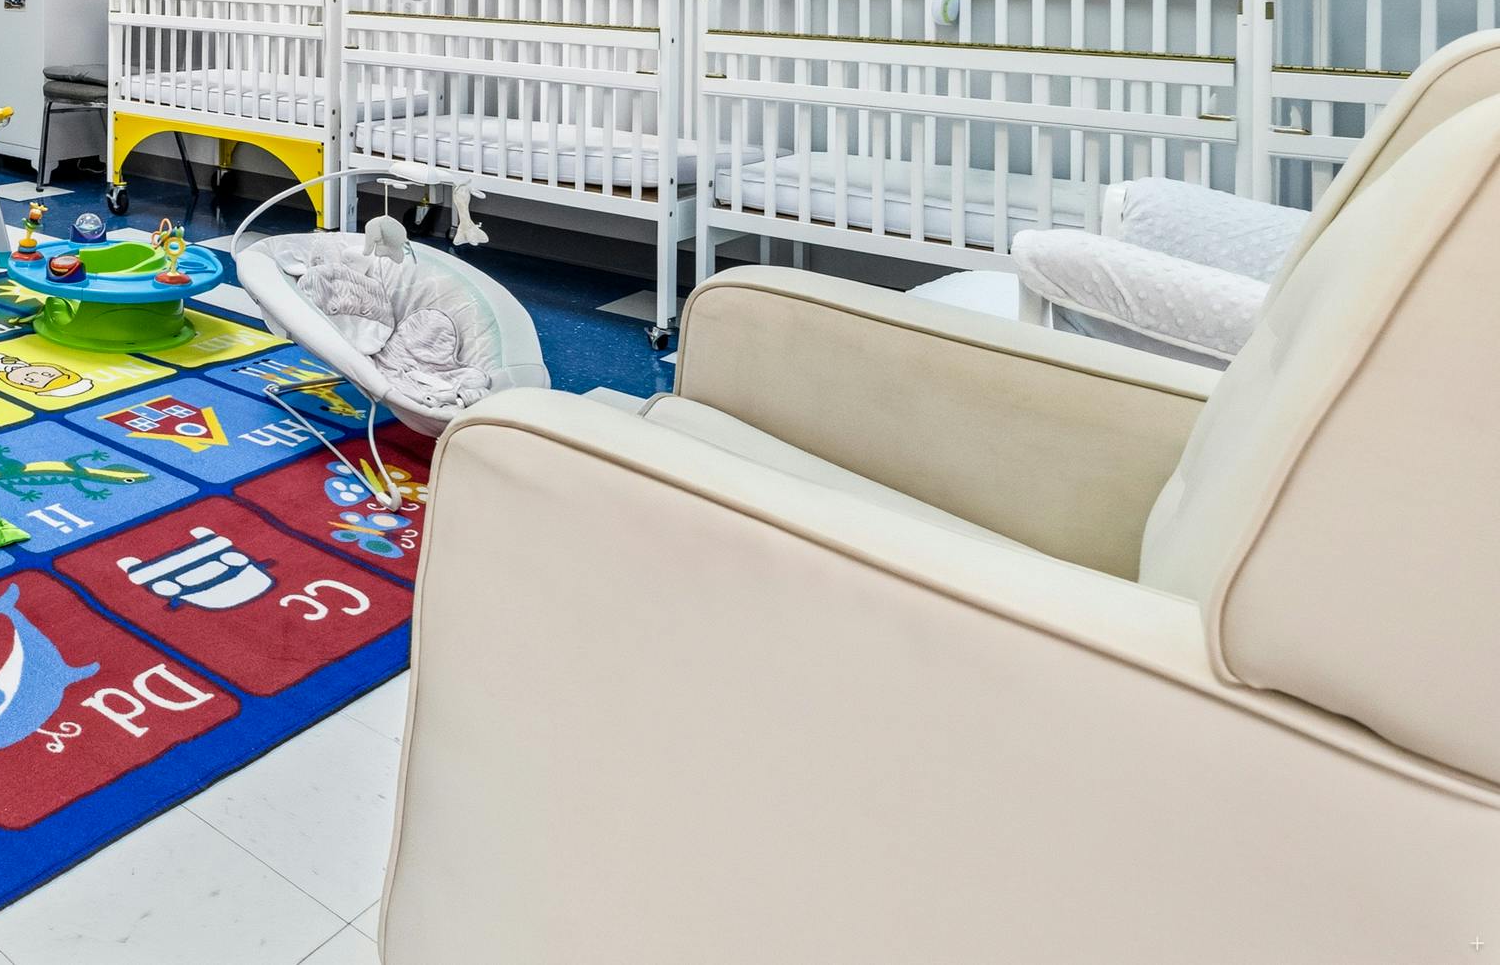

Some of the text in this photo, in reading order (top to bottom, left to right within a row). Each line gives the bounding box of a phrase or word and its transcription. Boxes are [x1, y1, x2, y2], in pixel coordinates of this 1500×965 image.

[238, 419, 325, 448] Hh
[26, 502, 95, 534] Ii
[279, 579, 370, 621] Cc
[80, 663, 215, 738] Dd
